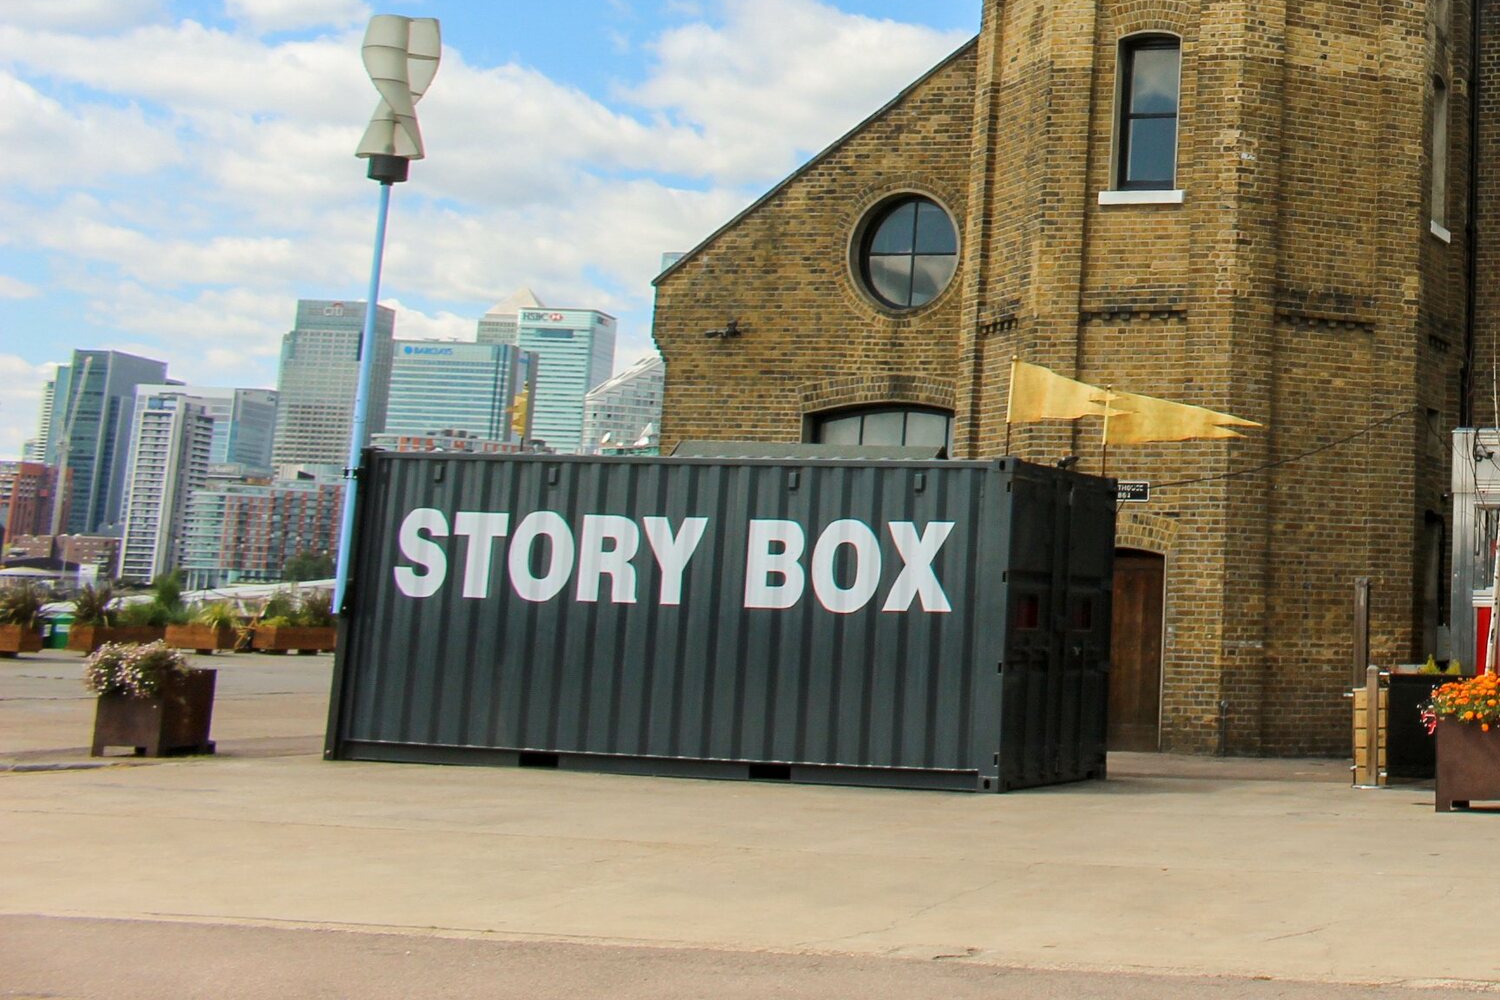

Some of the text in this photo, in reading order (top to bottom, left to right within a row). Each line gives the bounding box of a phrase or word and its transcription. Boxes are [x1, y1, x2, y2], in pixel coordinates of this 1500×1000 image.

[521, 311, 549, 321] HSBC
[394, 507, 956, 613] STORY BOX
